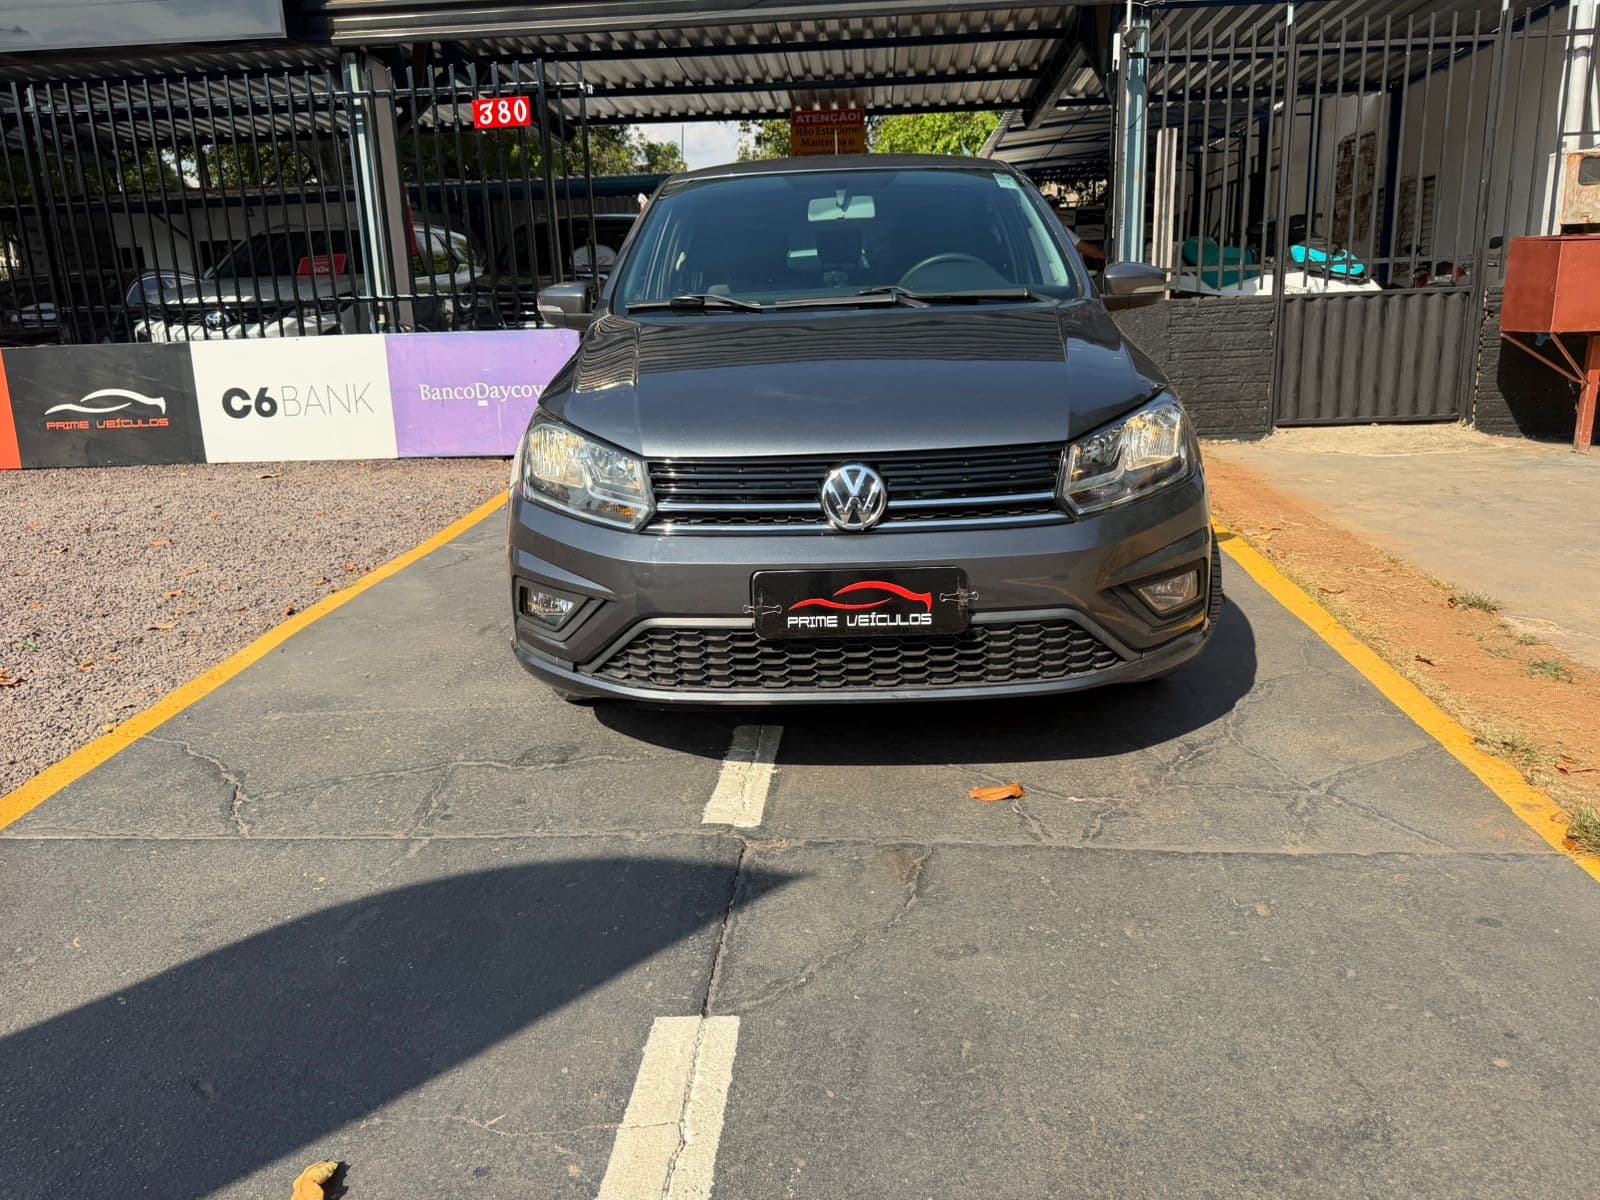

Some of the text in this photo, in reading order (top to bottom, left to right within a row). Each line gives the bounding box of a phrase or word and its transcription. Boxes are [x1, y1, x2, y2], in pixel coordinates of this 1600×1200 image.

[479, 99, 527, 125] 380
[796, 126, 814, 136] Não
[419, 382, 546, 402] BancoDaycov
[46, 421, 90, 430] PRIME
[787, 612, 932, 629] PRIME VEÍCULOS
